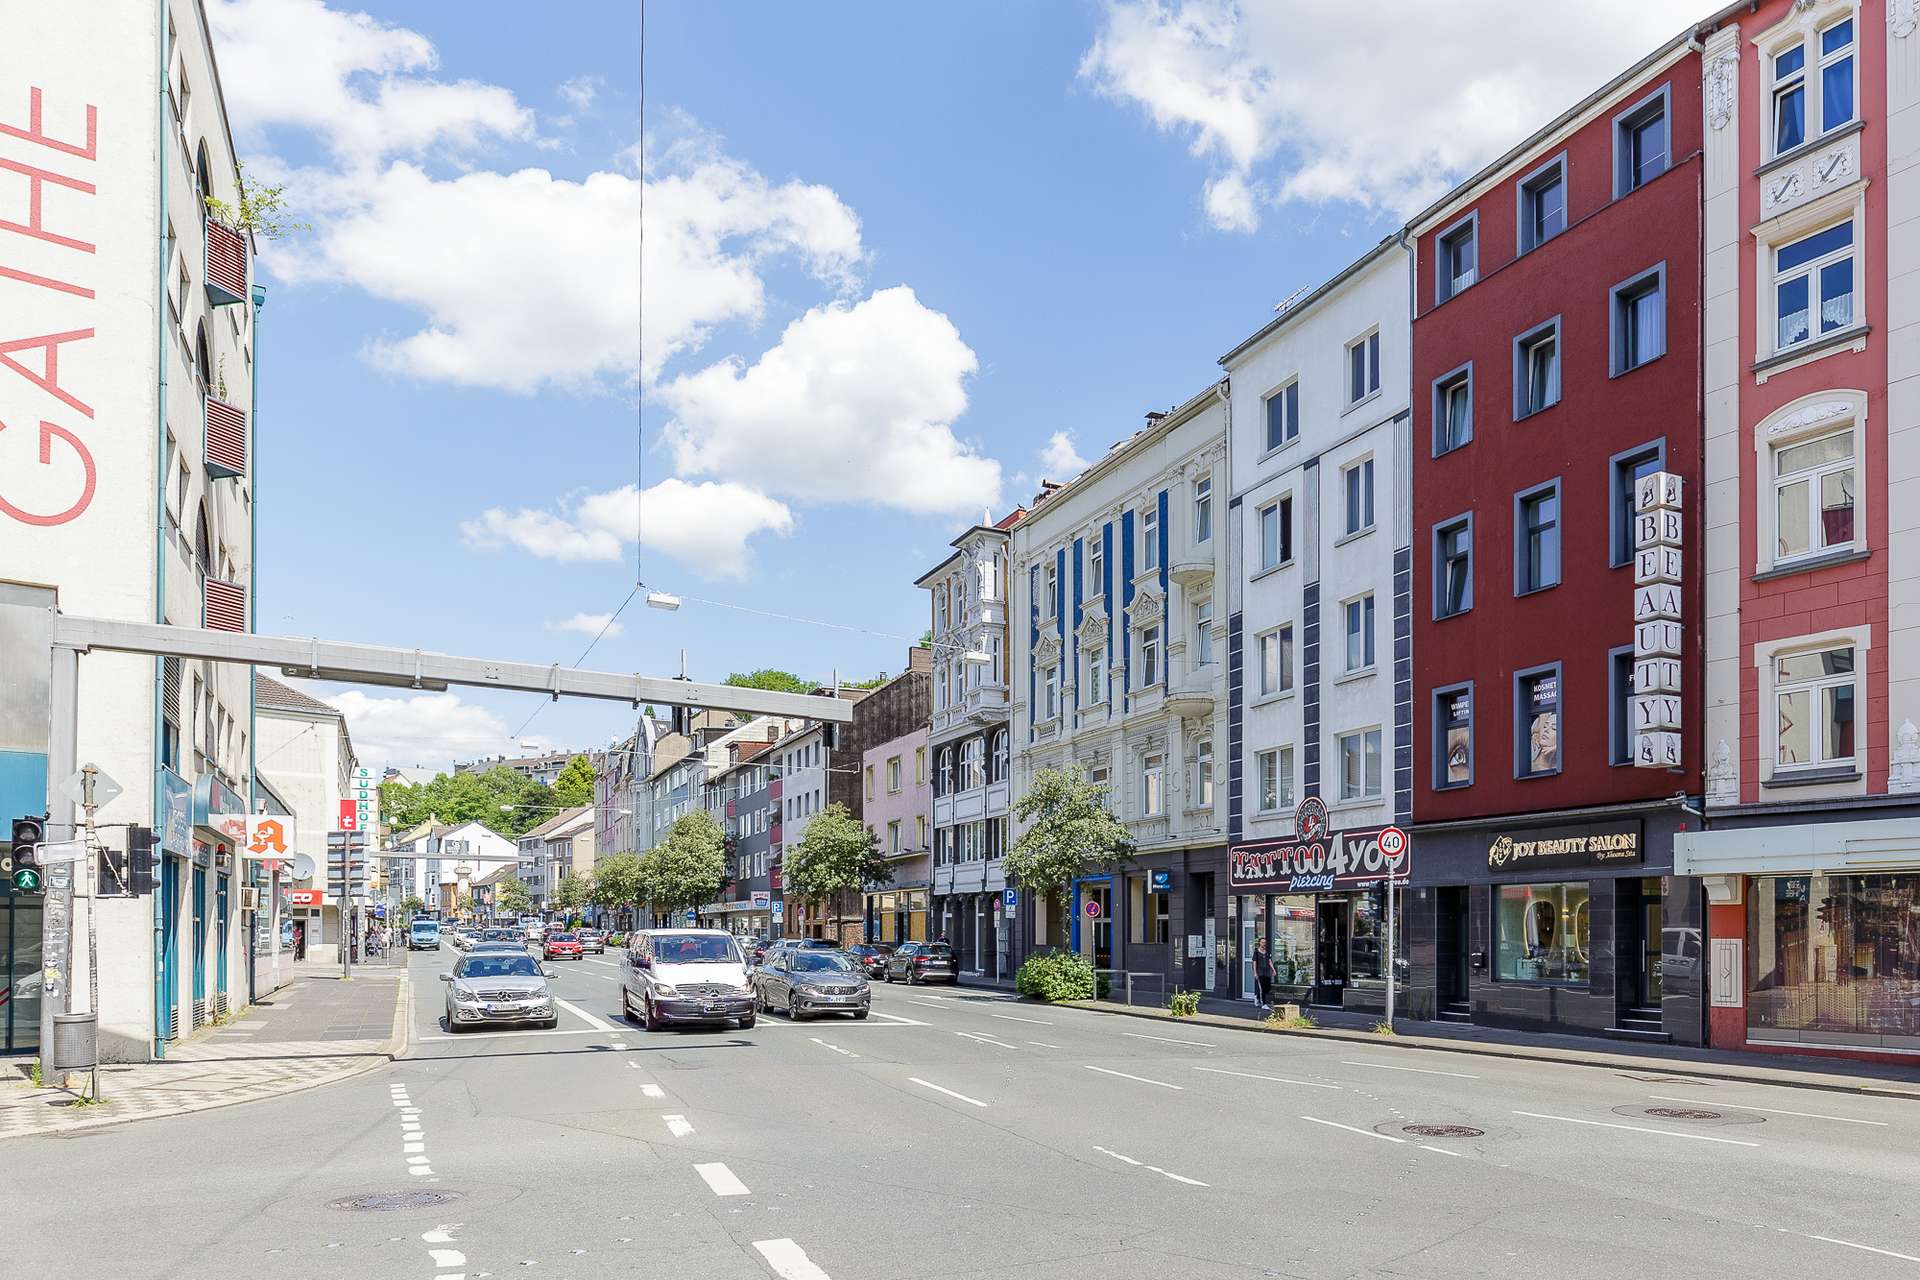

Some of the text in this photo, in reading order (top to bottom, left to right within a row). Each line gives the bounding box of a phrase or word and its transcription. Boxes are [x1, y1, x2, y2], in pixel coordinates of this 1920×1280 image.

[1638, 516, 1658, 725] BEAUTY
[1662, 513, 1680, 724] BEAUTY
[1384, 837, 1400, 849] 40
[1512, 841, 1537, 861] JOY
[1537, 837, 1588, 857] BEAUTY
[1589, 833, 1637, 852] SALON
[1232, 843, 1325, 879] TATTOO
[1289, 873, 1335, 892] piercing
